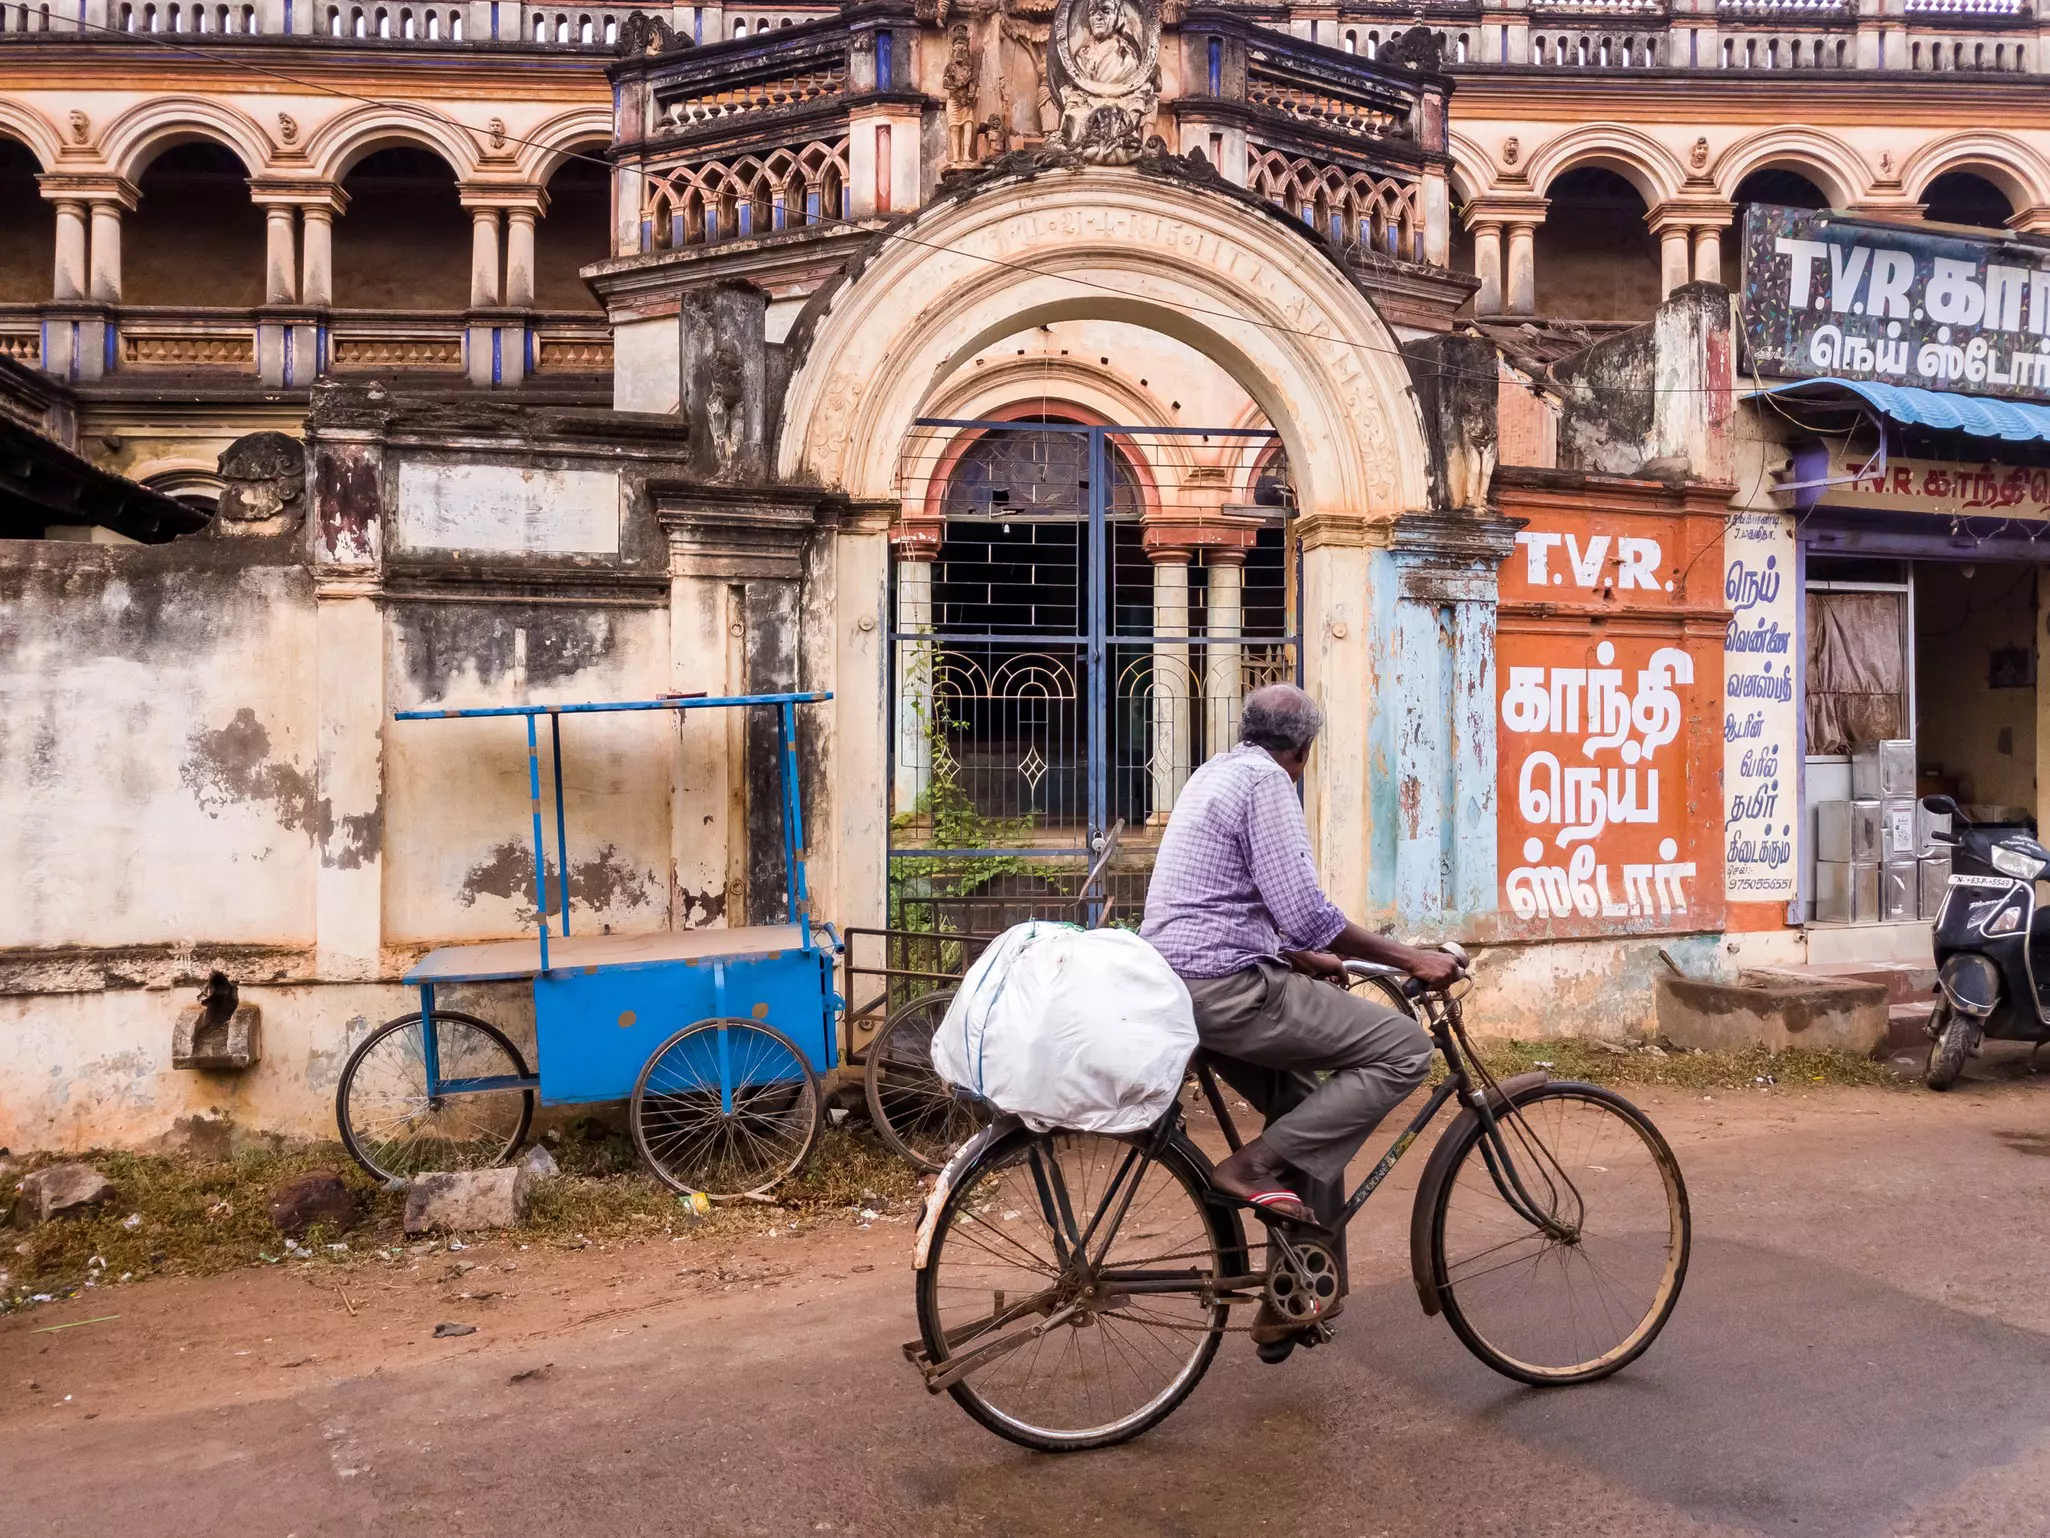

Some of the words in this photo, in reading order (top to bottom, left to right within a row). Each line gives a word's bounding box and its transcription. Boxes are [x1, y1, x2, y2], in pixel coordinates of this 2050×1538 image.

[1775, 238, 1924, 321] T.V.R.
[1810, 321, 1908, 375] நெய்
[1515, 532, 1676, 592] T.V.R.
[1726, 555, 1780, 615] நெய்
[1502, 641, 1695, 760] காந்தி
[1519, 742, 1659, 848] நெய்
[1725, 779, 1778, 832] தயிர்
[1727, 823, 1790, 870] கிடைக்கும்
[1506, 838, 1696, 920] ஸ்டோர்
